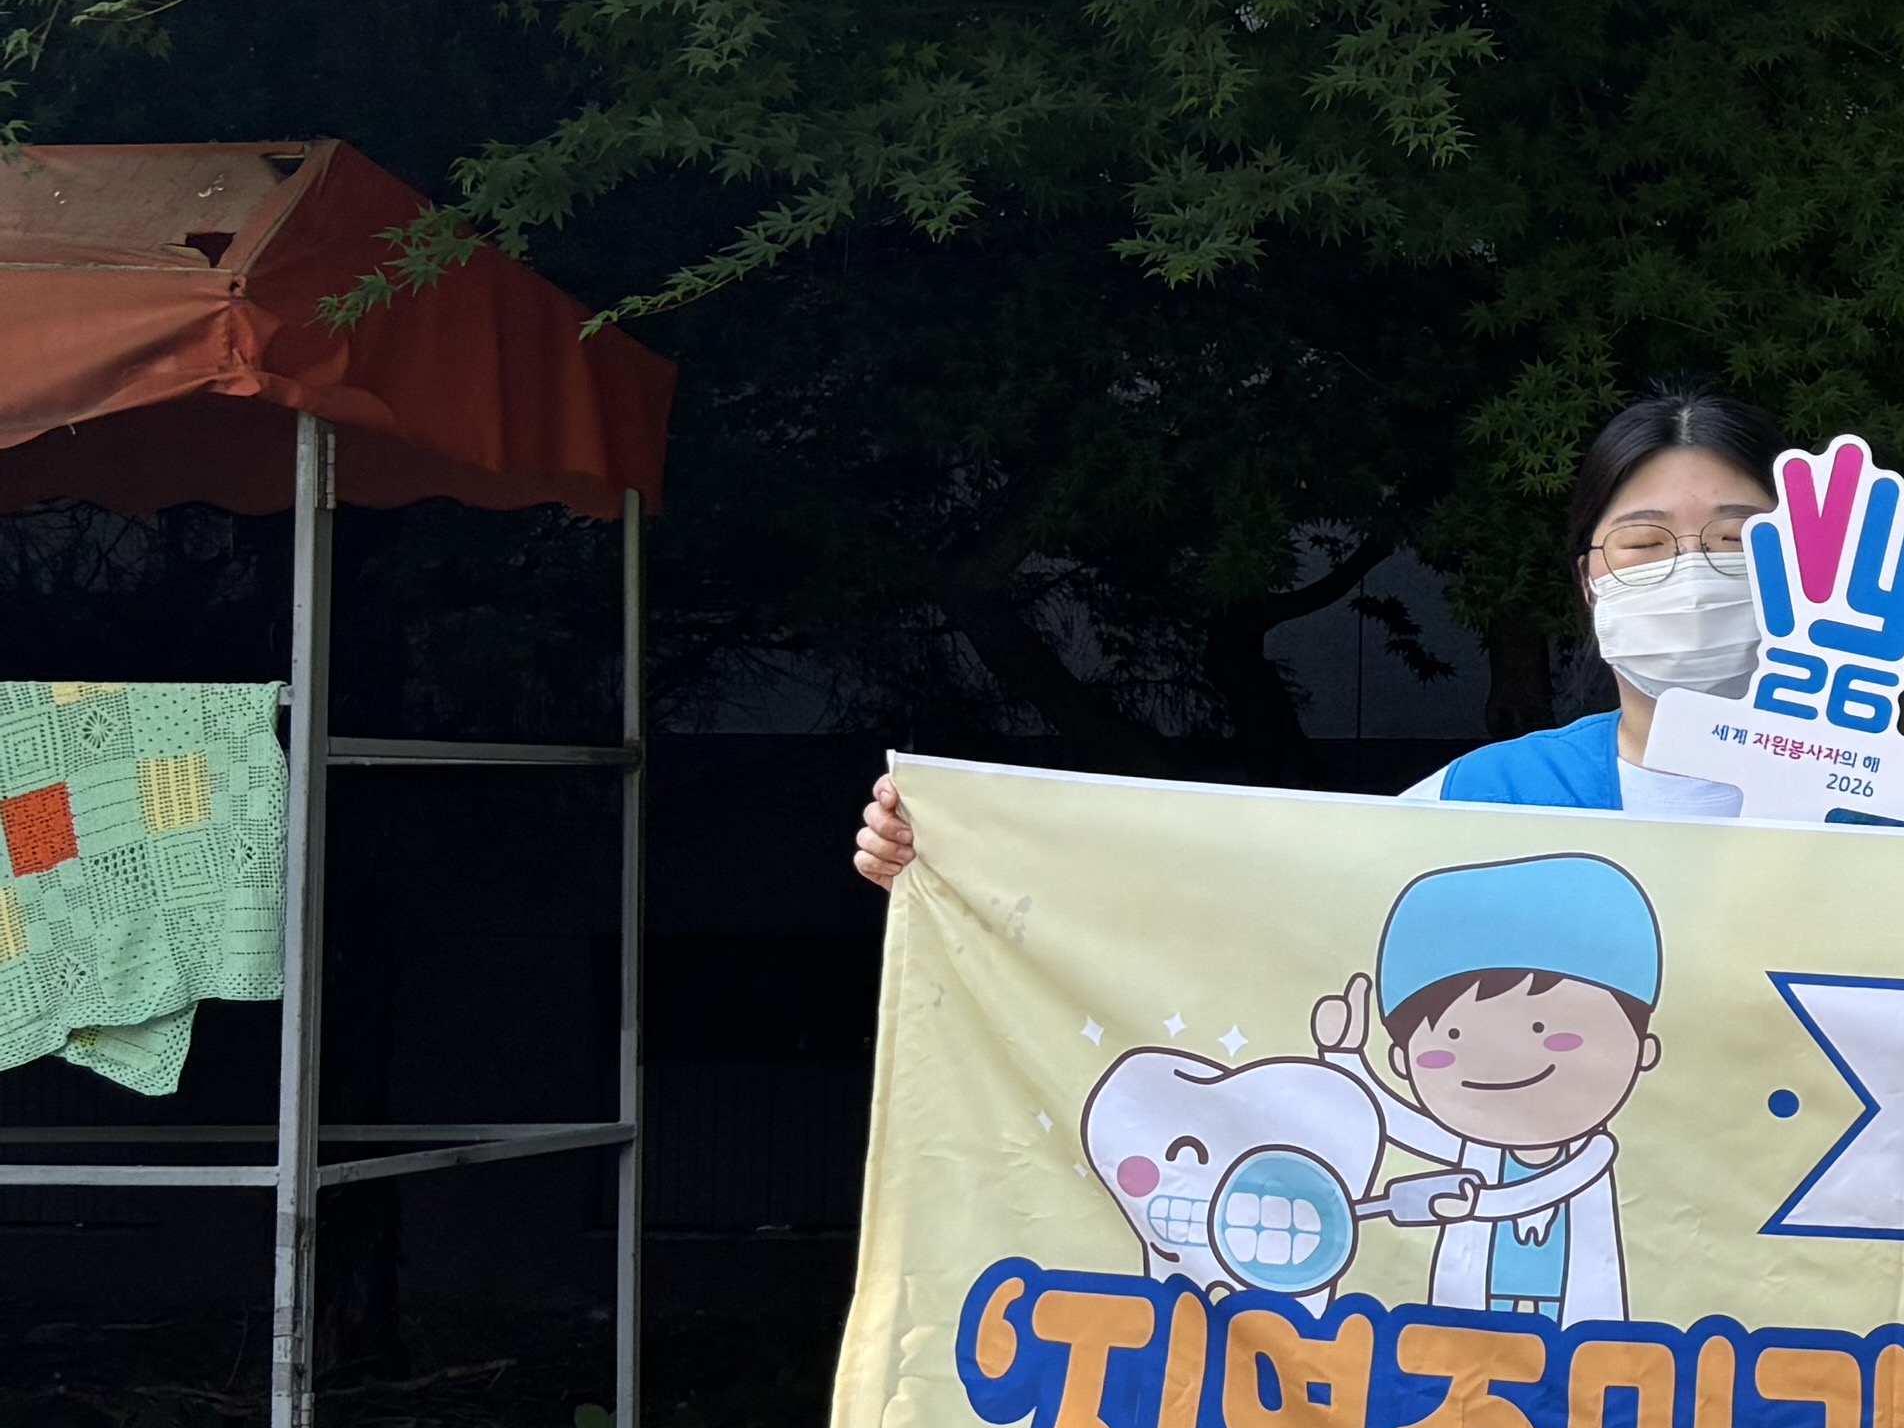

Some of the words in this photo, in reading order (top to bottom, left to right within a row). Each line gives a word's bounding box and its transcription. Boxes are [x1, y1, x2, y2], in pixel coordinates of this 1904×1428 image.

[1754, 647, 1900, 734] 26
[1712, 723, 1749, 746] 세계
[1752, 732, 1858, 768] 자원봉사자의
[1862, 755, 1881, 774] 해
[1826, 773, 1874, 798] 2026
